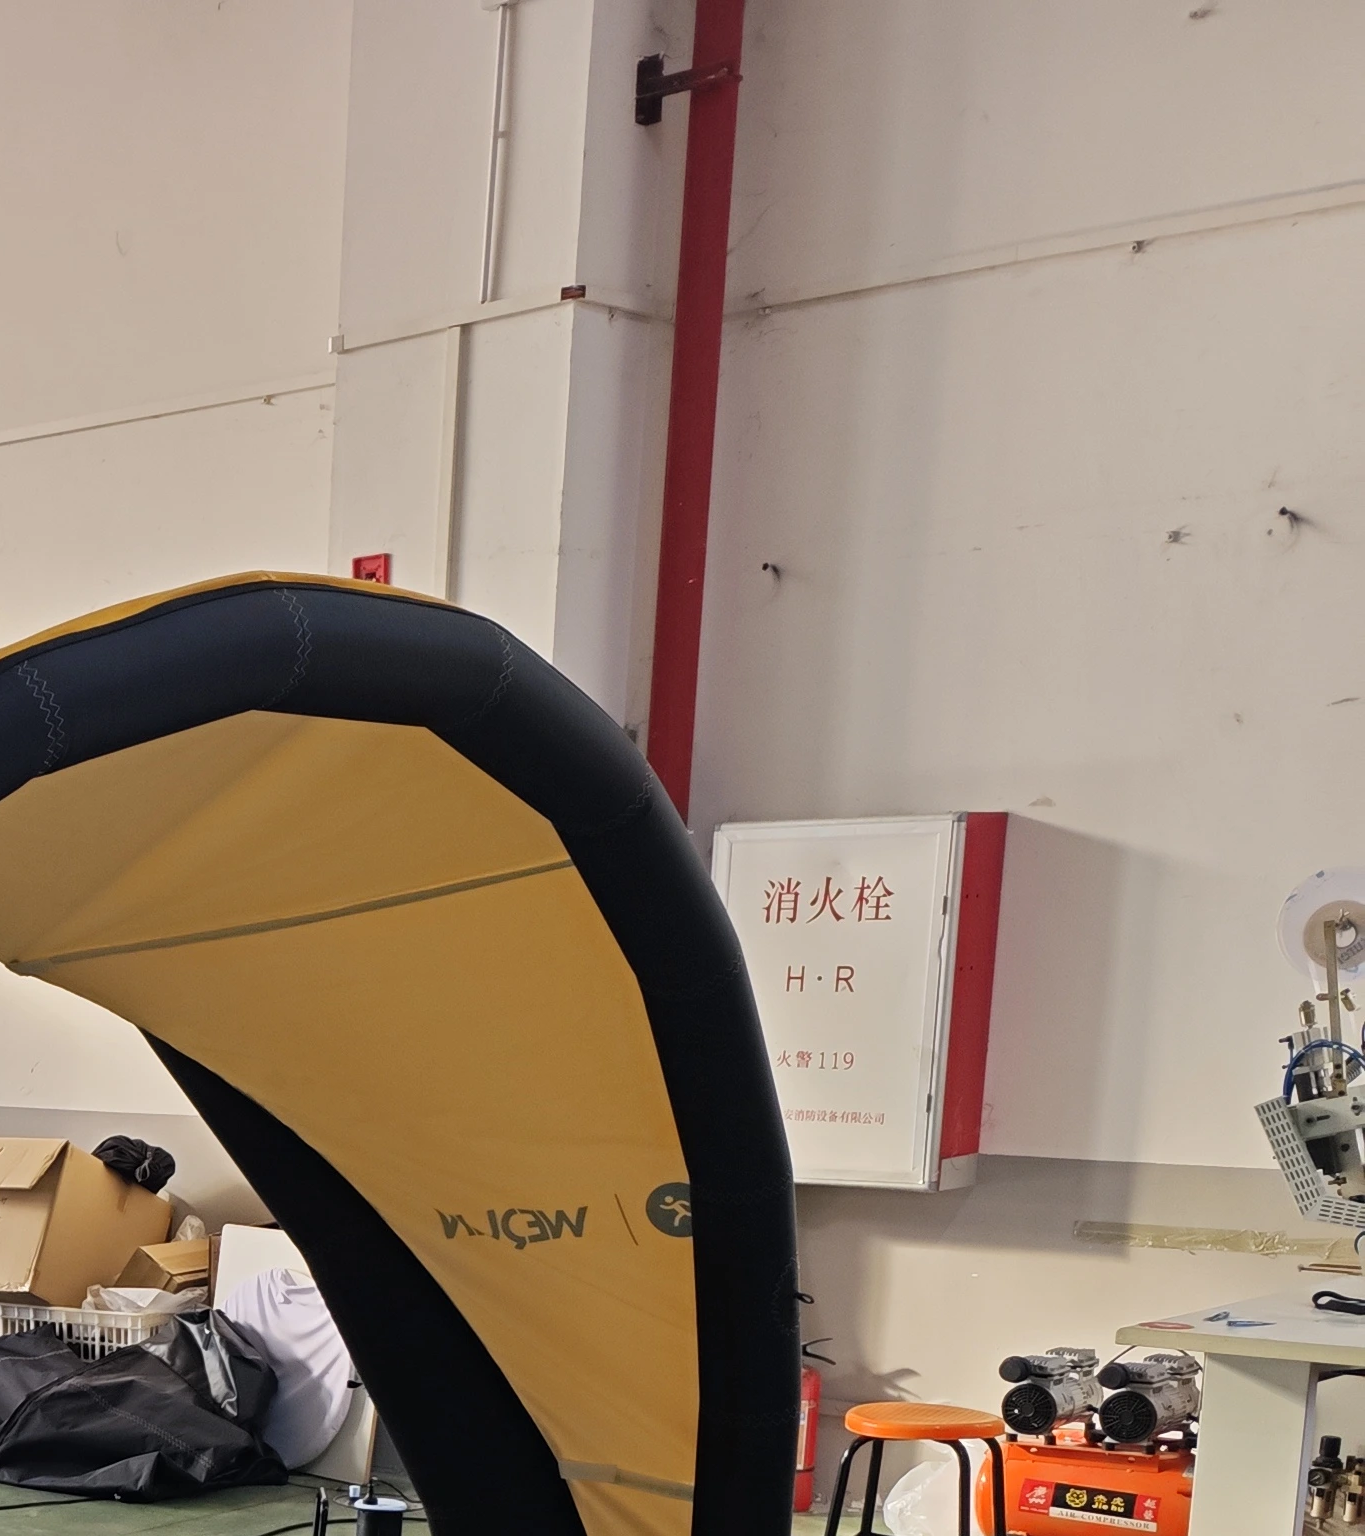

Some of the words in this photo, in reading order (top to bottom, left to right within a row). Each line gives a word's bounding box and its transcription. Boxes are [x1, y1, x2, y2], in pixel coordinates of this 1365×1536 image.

[762, 876, 895, 925] 消火栓
[784, 1109, 885, 1125] 安消防设备有限公司
[1057, 1510, 1077, 1519] AIR
[1080, 1513, 1151, 1530] COMPRESSOR
